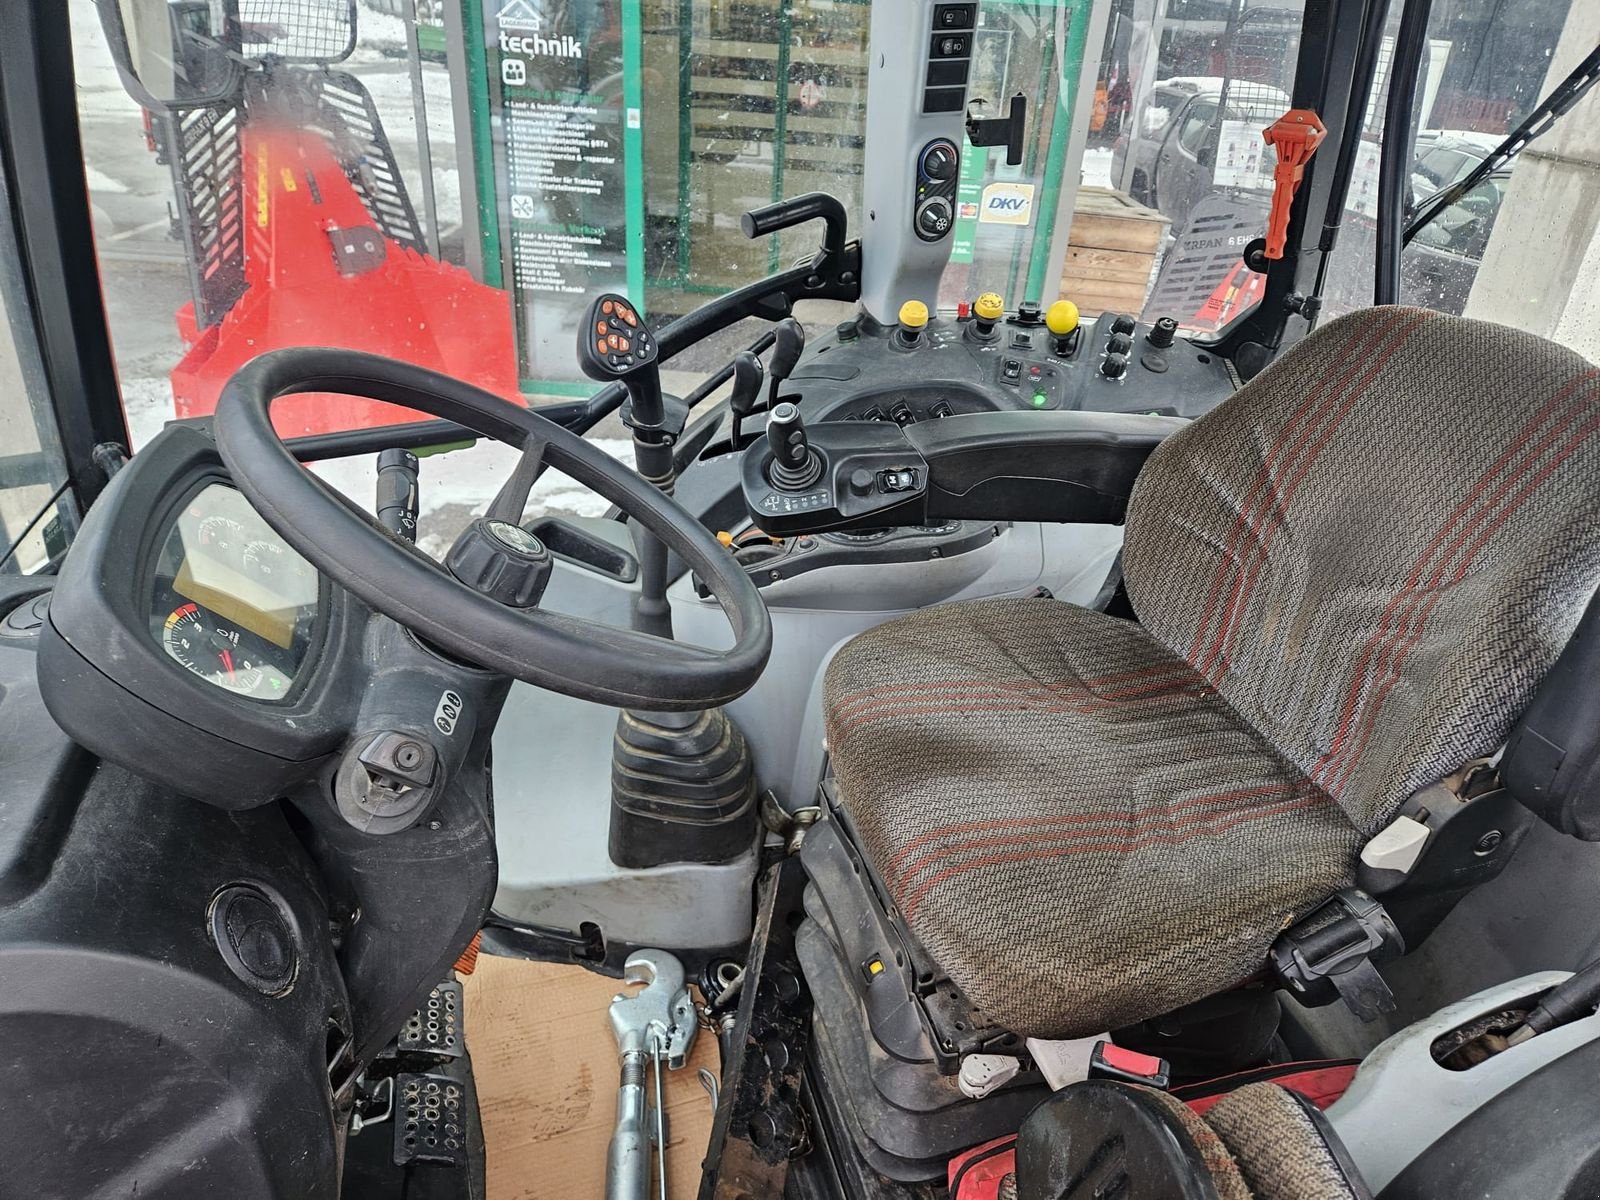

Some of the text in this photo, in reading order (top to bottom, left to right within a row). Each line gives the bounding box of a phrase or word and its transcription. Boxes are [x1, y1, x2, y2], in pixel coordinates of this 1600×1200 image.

[499, 30, 582, 58] technik
[988, 197, 1025, 210] DKV
[1228, 236, 1235, 246] 6
[193, 622, 203, 633] 3
[181, 638, 190, 649] 2
[243, 660, 252, 671] 0
